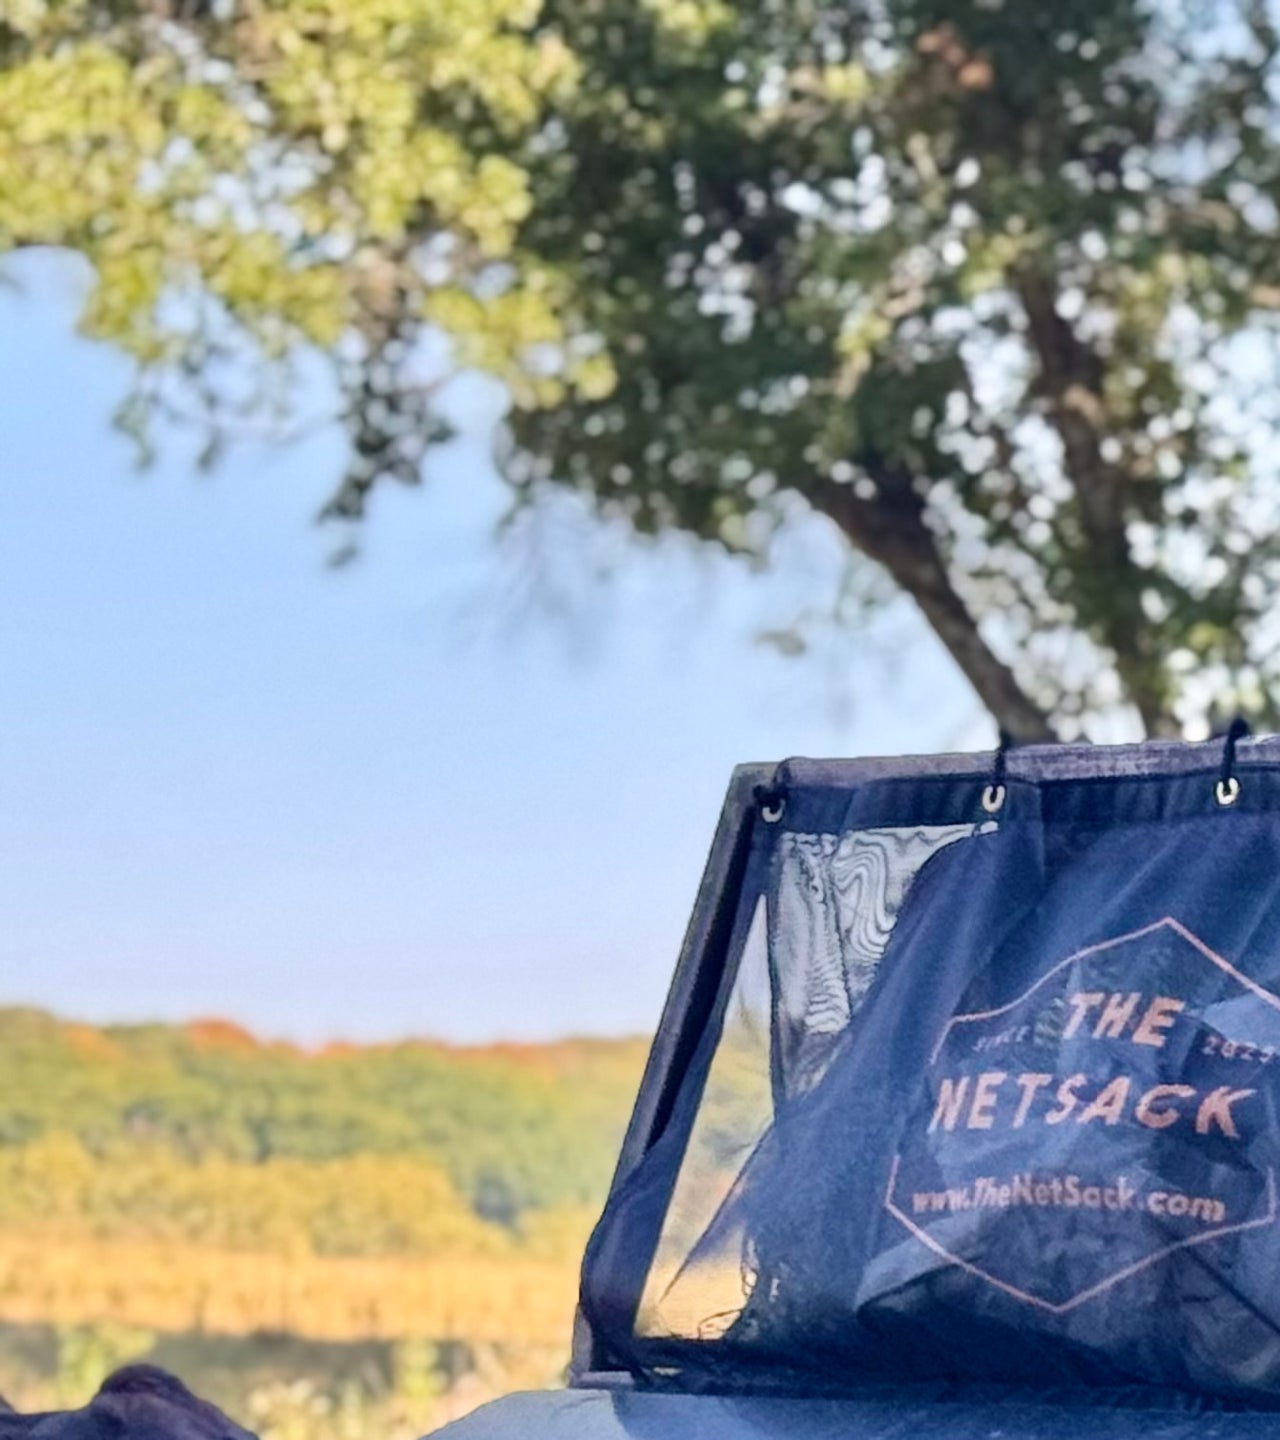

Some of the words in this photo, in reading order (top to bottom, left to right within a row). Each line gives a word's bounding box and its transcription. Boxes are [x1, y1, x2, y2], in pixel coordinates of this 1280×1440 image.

[1062, 992, 1186, 1048] THE
[927, 1072, 1258, 1138] NETSACK
[912, 1174, 1226, 1222] www.TheNetSack.com
